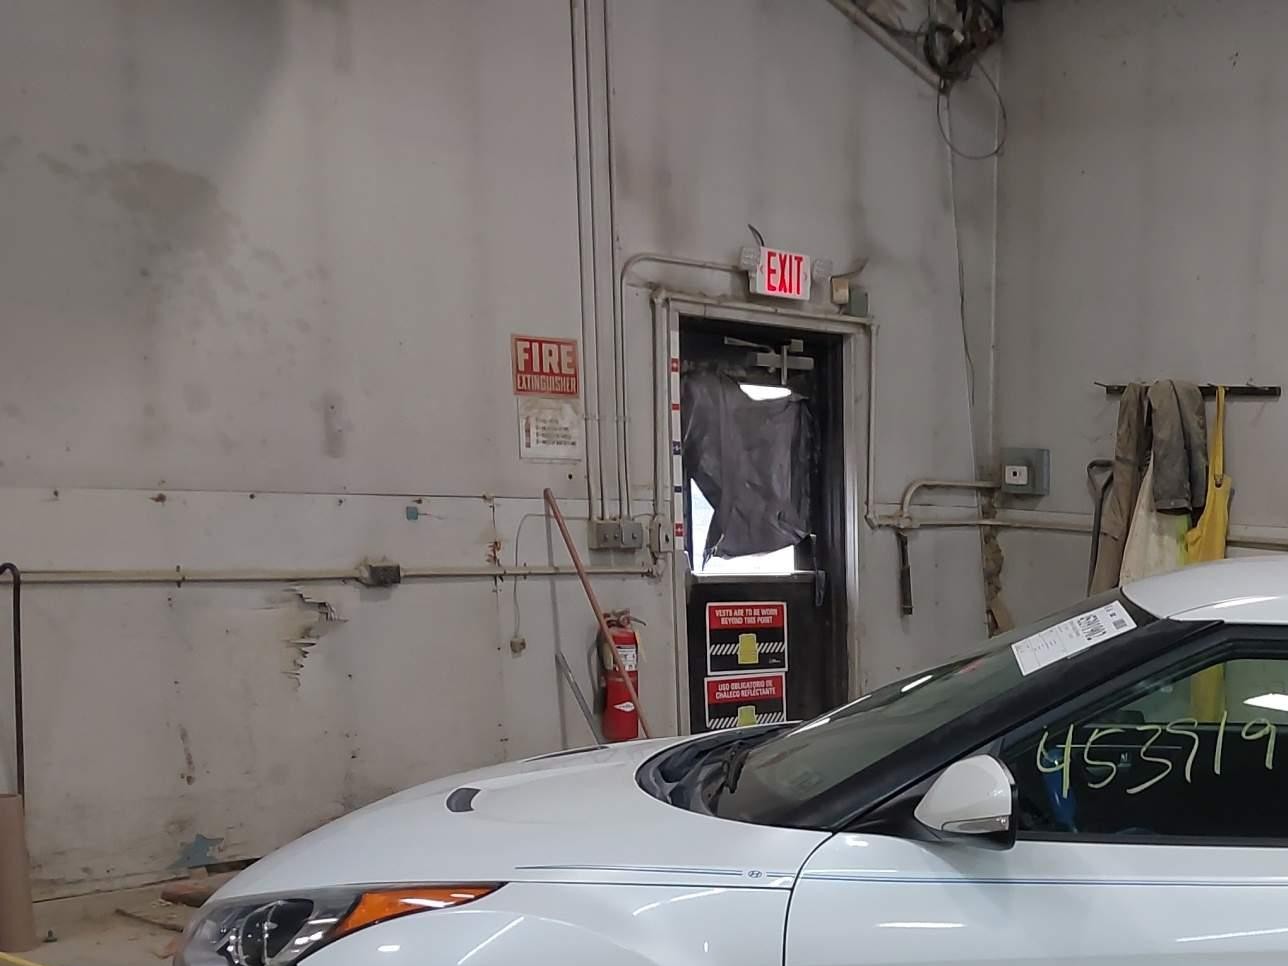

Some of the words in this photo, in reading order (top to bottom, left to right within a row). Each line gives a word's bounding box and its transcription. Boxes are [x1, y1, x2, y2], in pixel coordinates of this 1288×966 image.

[767, 251, 804, 295] EXIT
[516, 340, 576, 375] FIRE
[517, 374, 577, 393] EXTINGUISHER
[715, 609, 733, 617] VESTS
[733, 609, 744, 617] ARE
[761, 608, 778, 616] WORN
[721, 617, 744, 625] BEYOND
[757, 616, 773, 624] POINT
[718, 683, 730, 691] USO
[731, 681, 765, 690] OBLIGATORIO
[715, 691, 741, 700] CHALECO
